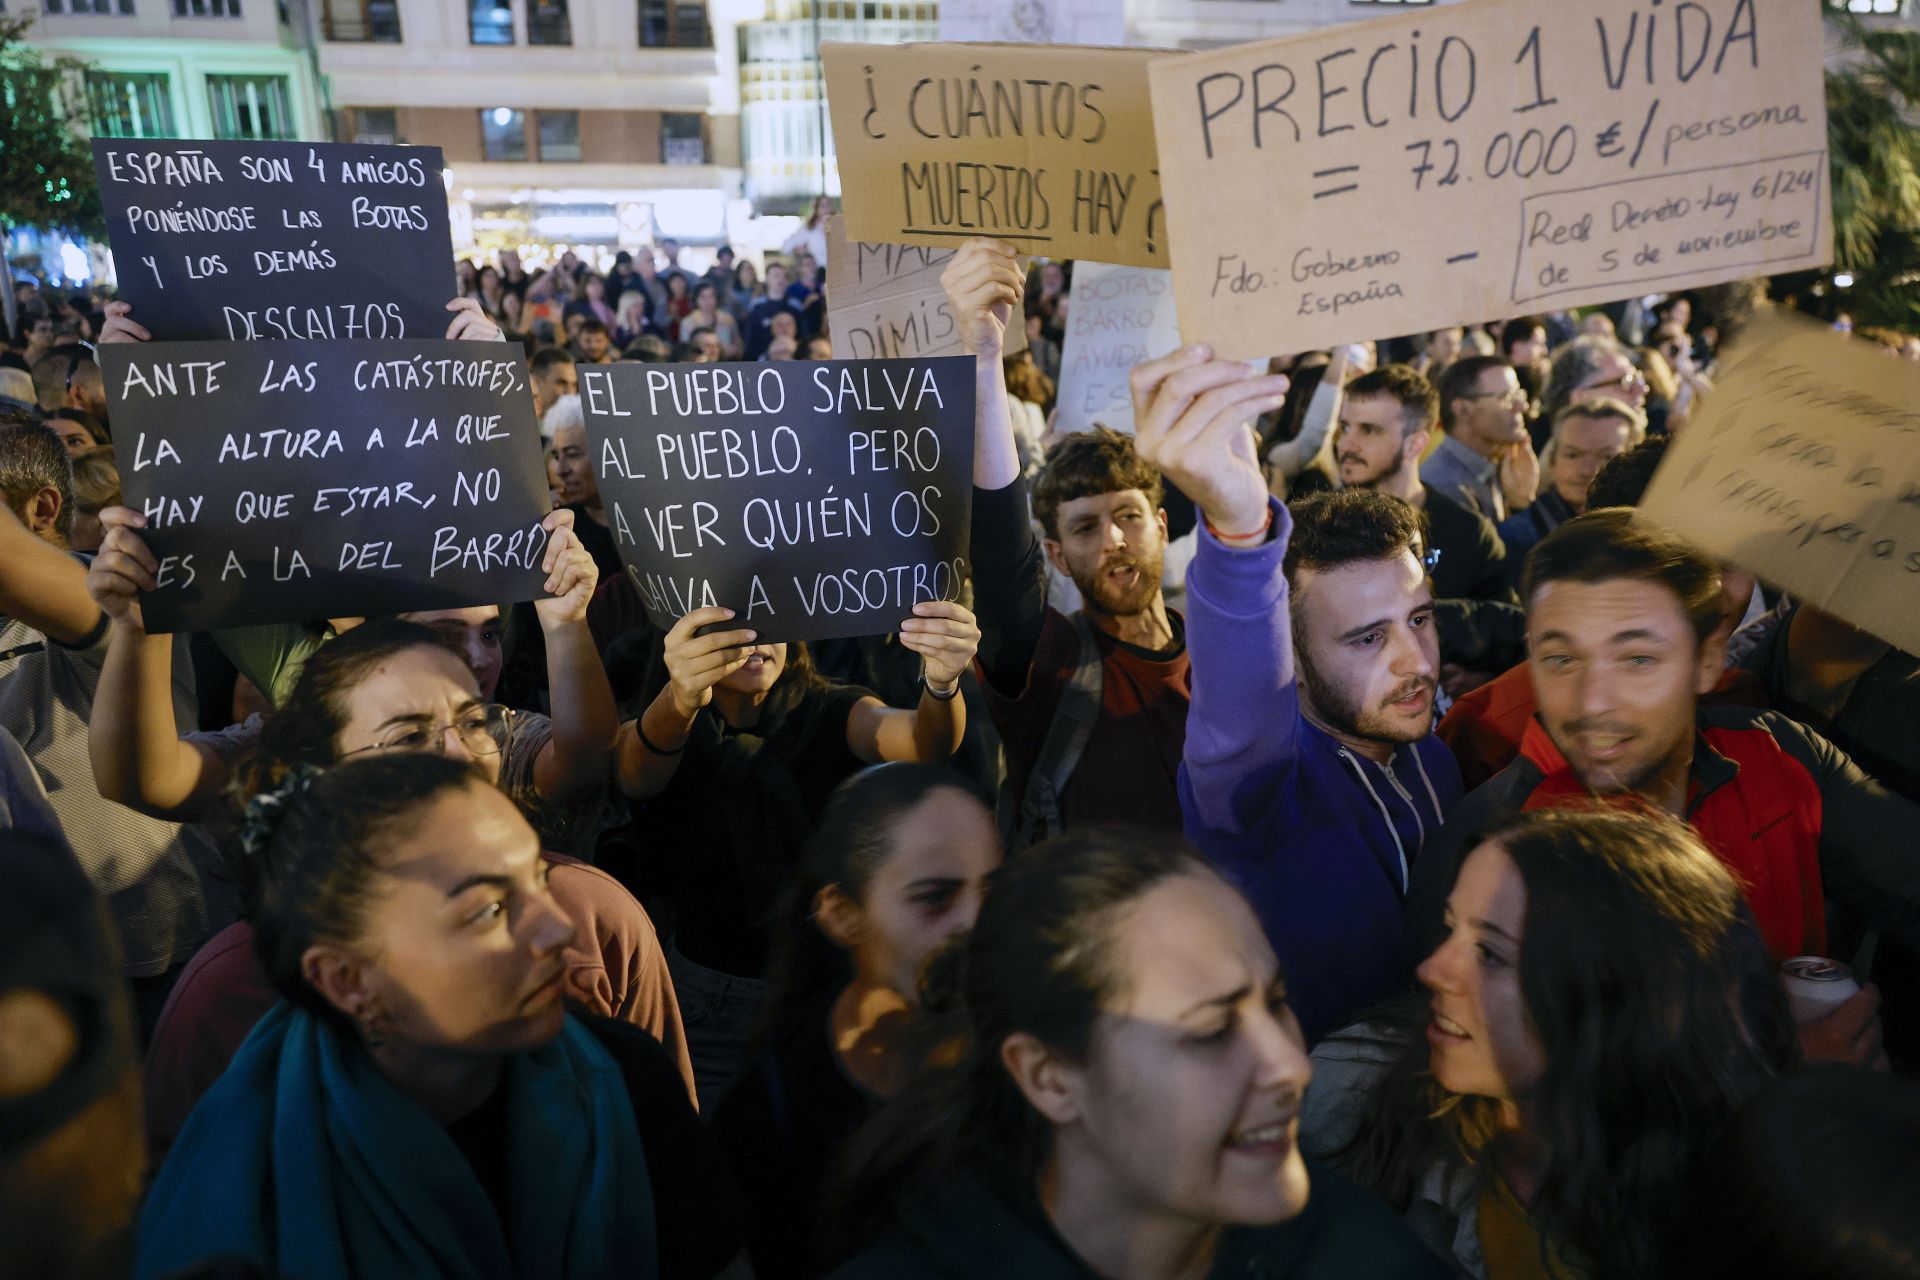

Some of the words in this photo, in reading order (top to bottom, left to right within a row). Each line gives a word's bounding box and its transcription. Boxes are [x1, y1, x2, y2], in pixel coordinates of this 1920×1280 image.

[1512, 25, 1558, 114] 1
[106, 150, 224, 185] ESPAÑA
[240, 155, 294, 184] SON
[307, 148, 326, 183] 4
[1405, 122, 1578, 190] 72.000
[902, 161, 1051, 230] MUERTOS
[1751, 170, 1814, 199] 6/24
[282, 208, 322, 230] LAS
[352, 196, 429, 232] BOTAS
[185, 254, 229, 280] LOS
[254, 240, 337, 276] DEMÁS
[1291, 247, 1400, 283] Gobierno
[1539, 263, 1569, 287] de
[1633, 244, 1661, 266] de
[1677, 219, 1802, 254] noviembre
[1079, 275, 1166, 302] BOTAS
[1297, 280, 1403, 316] España
[1074, 305, 1154, 336] BARRO
[122, 361, 226, 400] ANTE
[259, 359, 318, 393] LAS
[585, 371, 632, 417] EL
[646, 368, 785, 417] PUEBLO
[813, 367, 944, 415] SALVA
[133, 433, 182, 472] LA
[219, 429, 344, 464] ALTURA
[366, 428, 384, 451] A
[405, 417, 439, 449] LA
[455, 414, 510, 444] QUE
[601, 437, 646, 480] AL
[849, 426, 941, 475] PERO
[144, 495, 203, 529] HAY
[235, 490, 295, 524] QUE
[313, 481, 437, 516] ESTAR,
[453, 467, 501, 507] NO
[614, 501, 635, 547] A
[645, 501, 726, 558] VER
[743, 485, 872, 551] QUIÉN
[891, 485, 943, 538] OS
[157, 554, 195, 589] ES
[221, 550, 247, 581] A
[273, 546, 311, 581] LA
[338, 541, 402, 572] DEL
[430, 522, 547, 577] BARRO
[629, 564, 720, 619] SALVA
[746, 574, 775, 621] A
[794, 556, 966, 617] VOSOTROS
